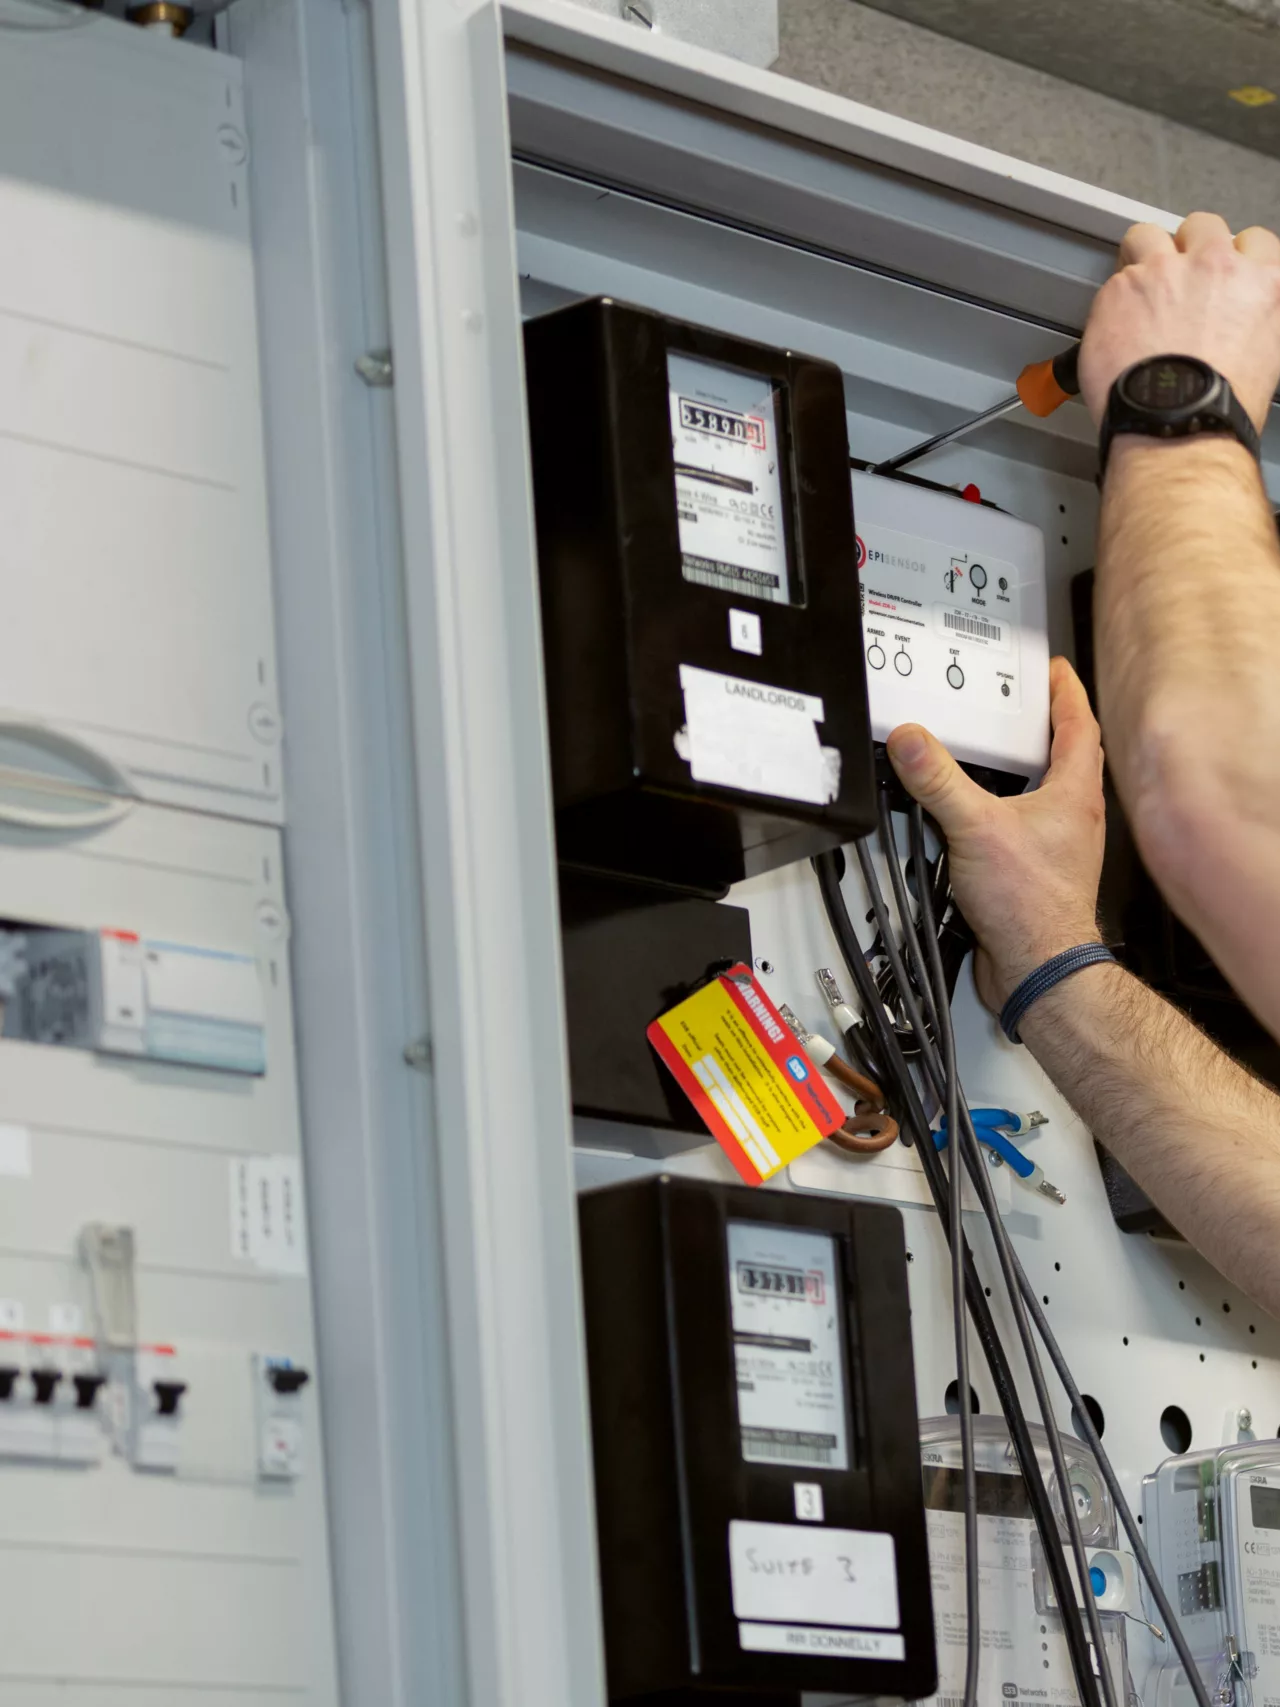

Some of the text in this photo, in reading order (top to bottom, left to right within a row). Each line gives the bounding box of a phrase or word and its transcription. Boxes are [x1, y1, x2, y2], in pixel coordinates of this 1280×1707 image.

[868, 550, 926, 573] EPISENSOR
[971, 597, 986, 606] MODE
[867, 627, 885, 638] ARMED
[894, 634, 911, 644] EVENT
[949, 648, 960, 656] EXIT
[725, 681, 806, 712] LANDLORDS
[1244, 1542, 1256, 1554] CE
